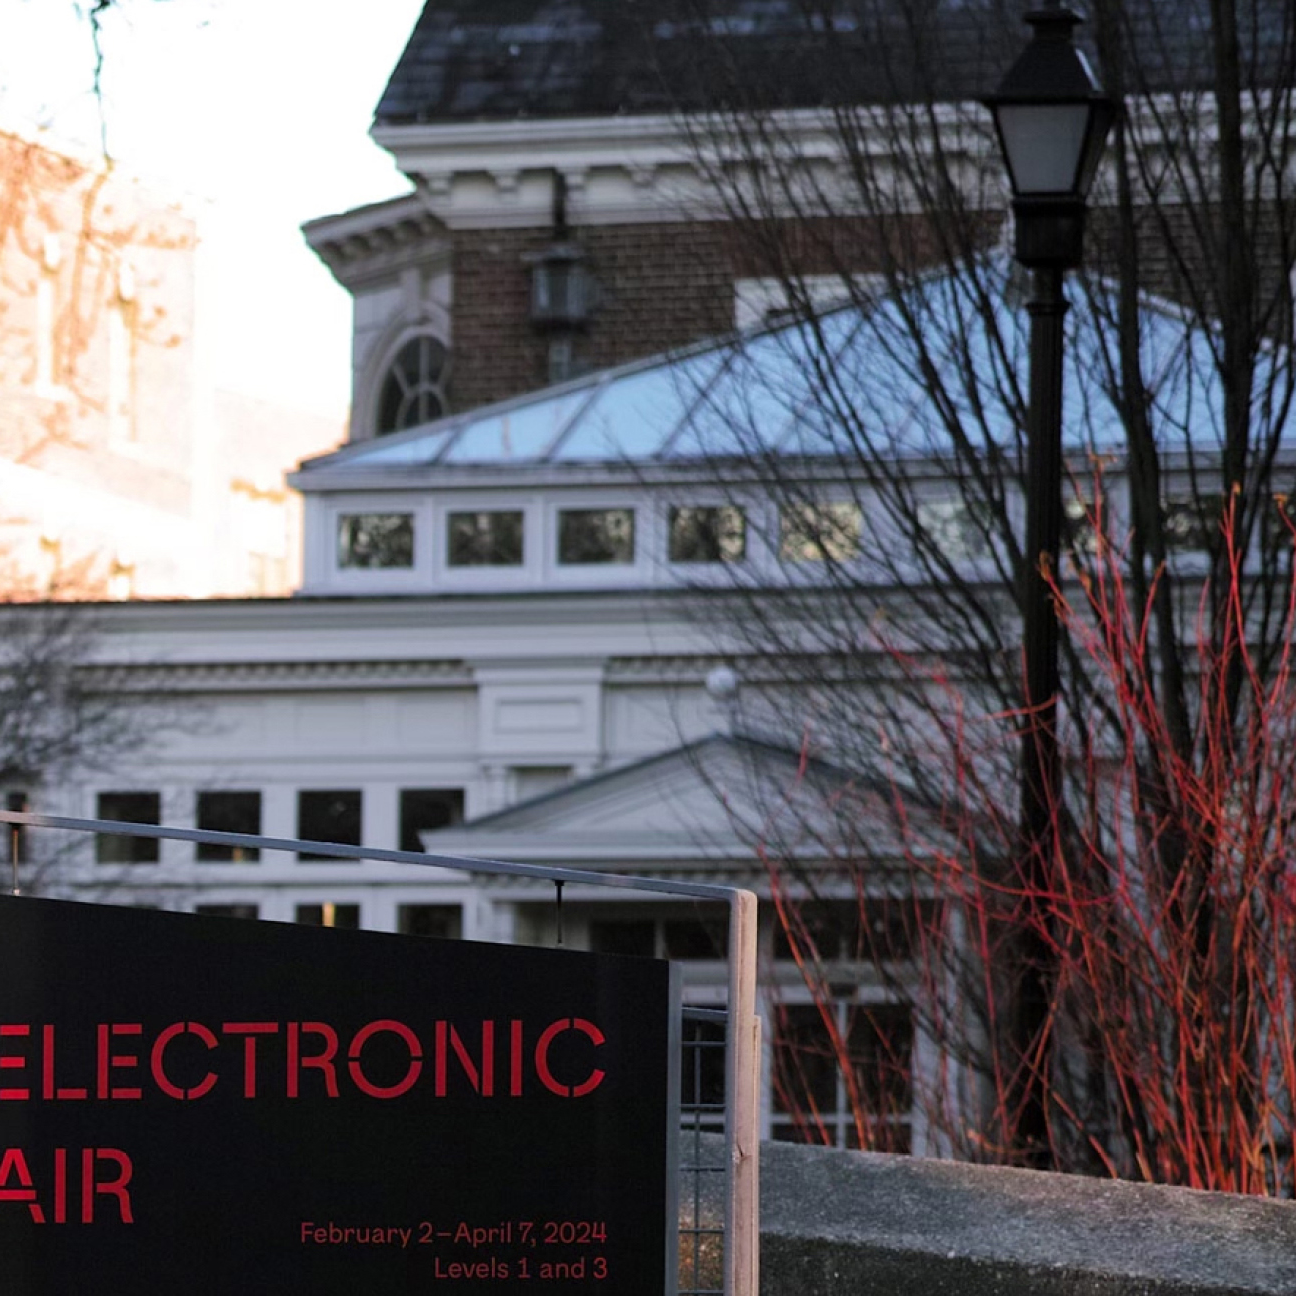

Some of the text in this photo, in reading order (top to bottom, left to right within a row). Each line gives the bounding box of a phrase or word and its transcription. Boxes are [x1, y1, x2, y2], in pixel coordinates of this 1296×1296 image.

[300, 1222, 411, 1247] February
[519, 1222, 537, 1246] 7,
[544, 1222, 608, 1244] 2024
[435, 1257, 608, 1279] Levels 1 and 3
